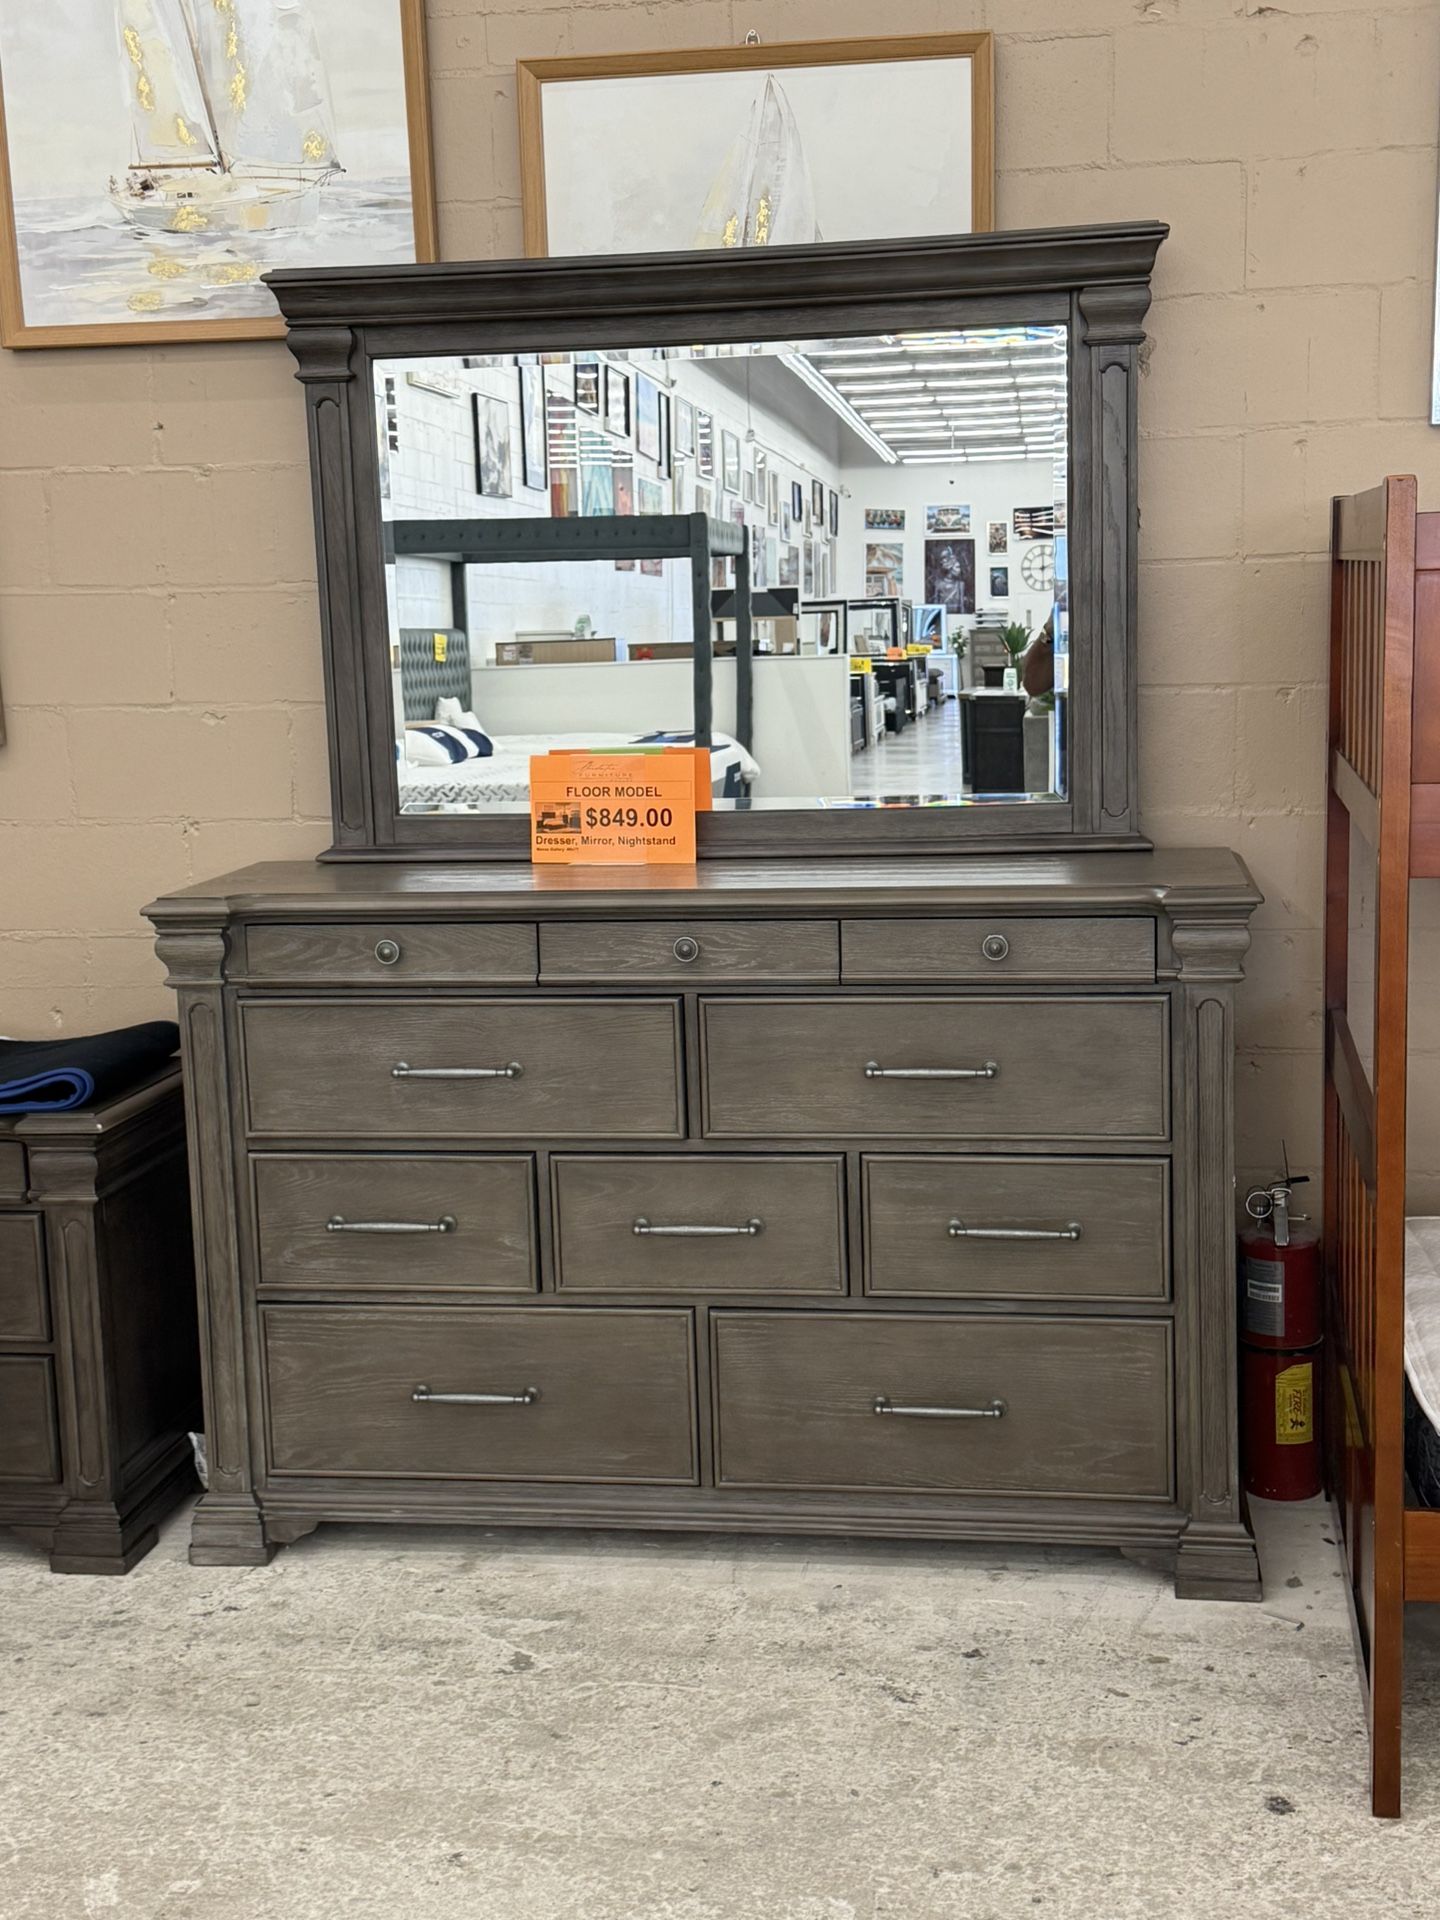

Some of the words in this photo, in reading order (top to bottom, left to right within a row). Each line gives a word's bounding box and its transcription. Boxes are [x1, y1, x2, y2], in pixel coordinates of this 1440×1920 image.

[566, 786, 611, 798] FLOOR
[615, 786, 662, 798] MODEL
[586, 807, 673, 829] $849.00
[535, 835, 578, 847] Dresser,
[581, 836, 615, 847] Mirror,
[618, 836, 676, 848] Nightstand
